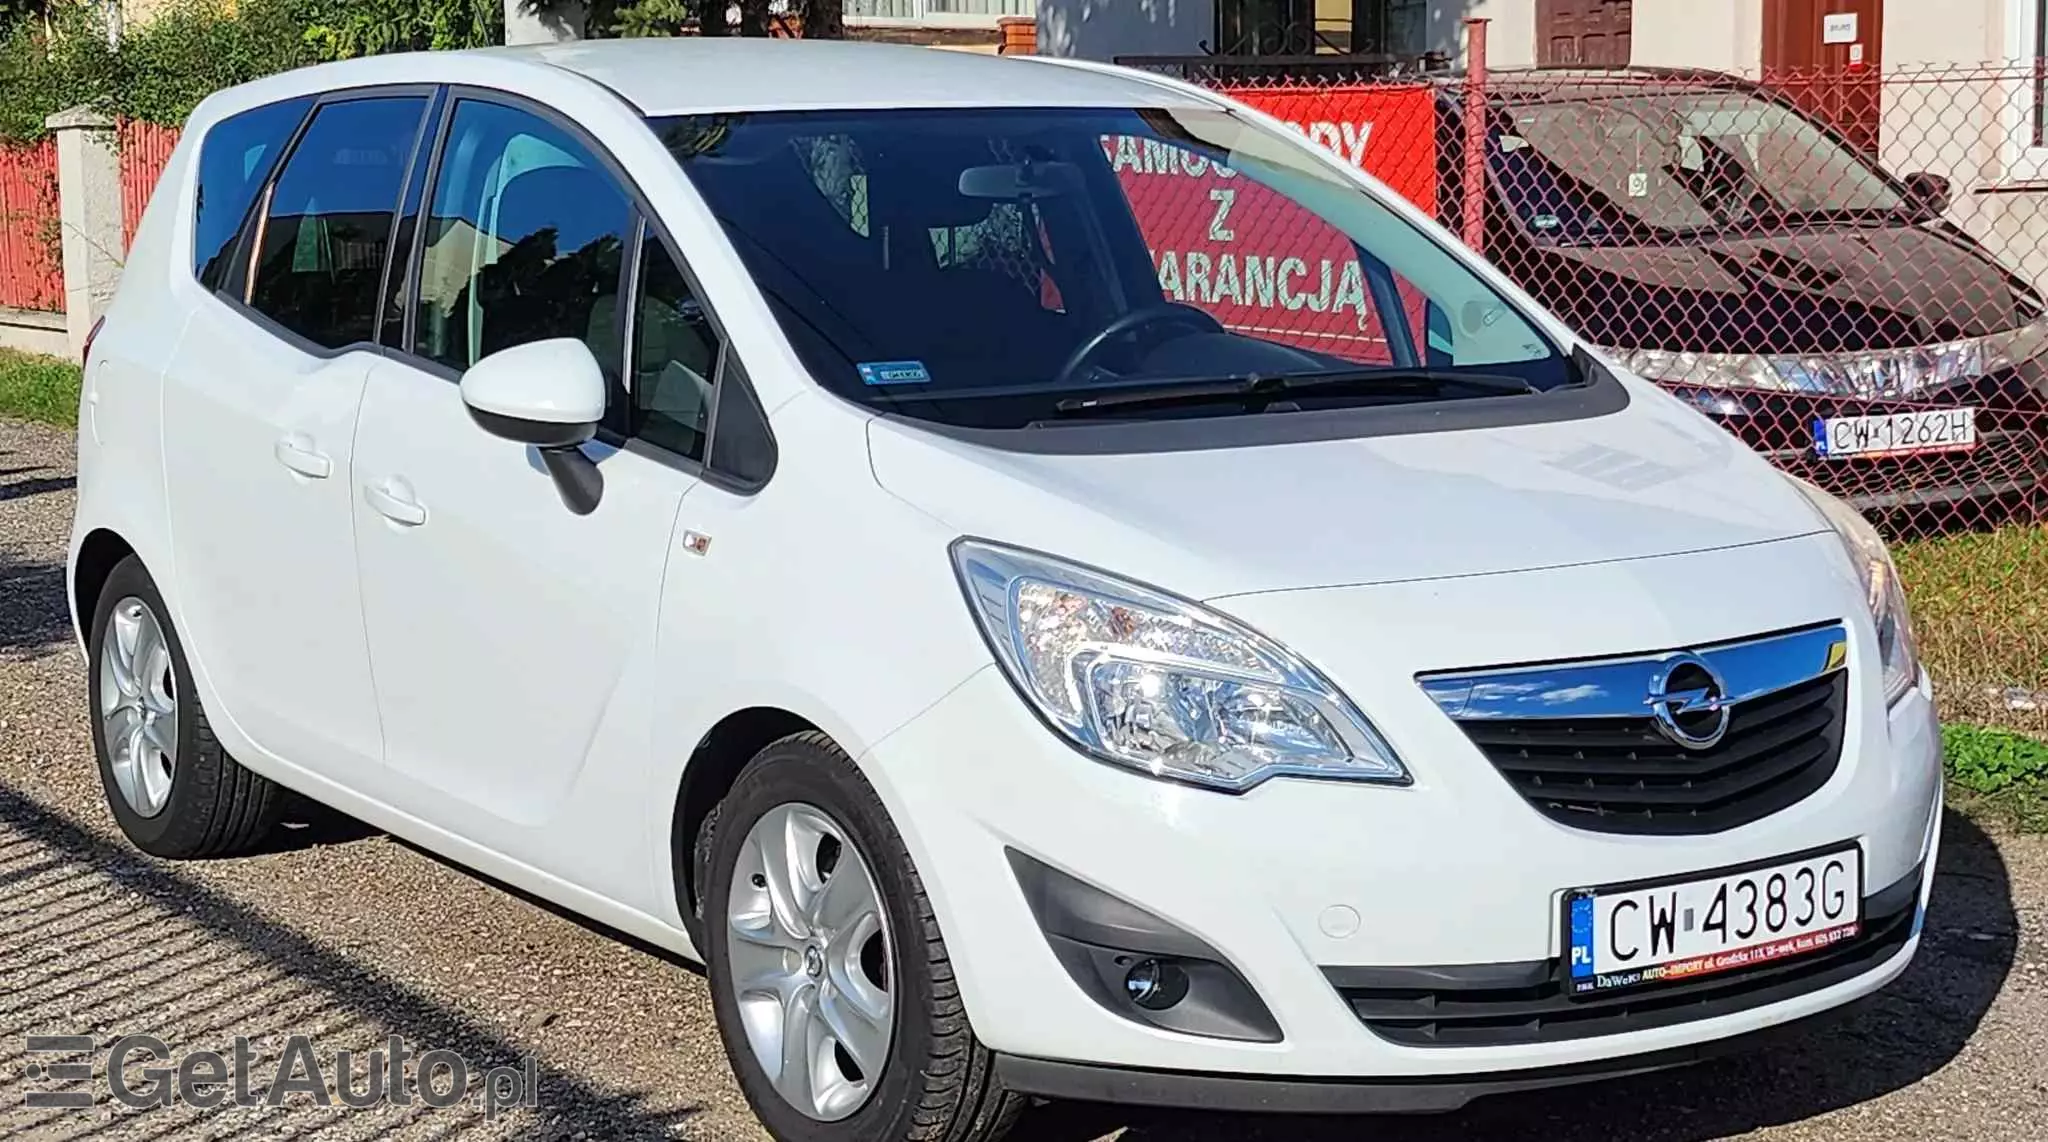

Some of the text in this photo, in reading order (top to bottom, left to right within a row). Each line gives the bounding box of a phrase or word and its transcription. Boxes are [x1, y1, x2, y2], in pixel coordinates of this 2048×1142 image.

[1209, 189, 1236, 242] Z
[1149, 249, 1368, 331] ARANCJĄ
[1834, 411, 1967, 449] CW 1262H
[1610, 860, 1845, 961] CW 4383G
[1571, 946, 1592, 965] PL
